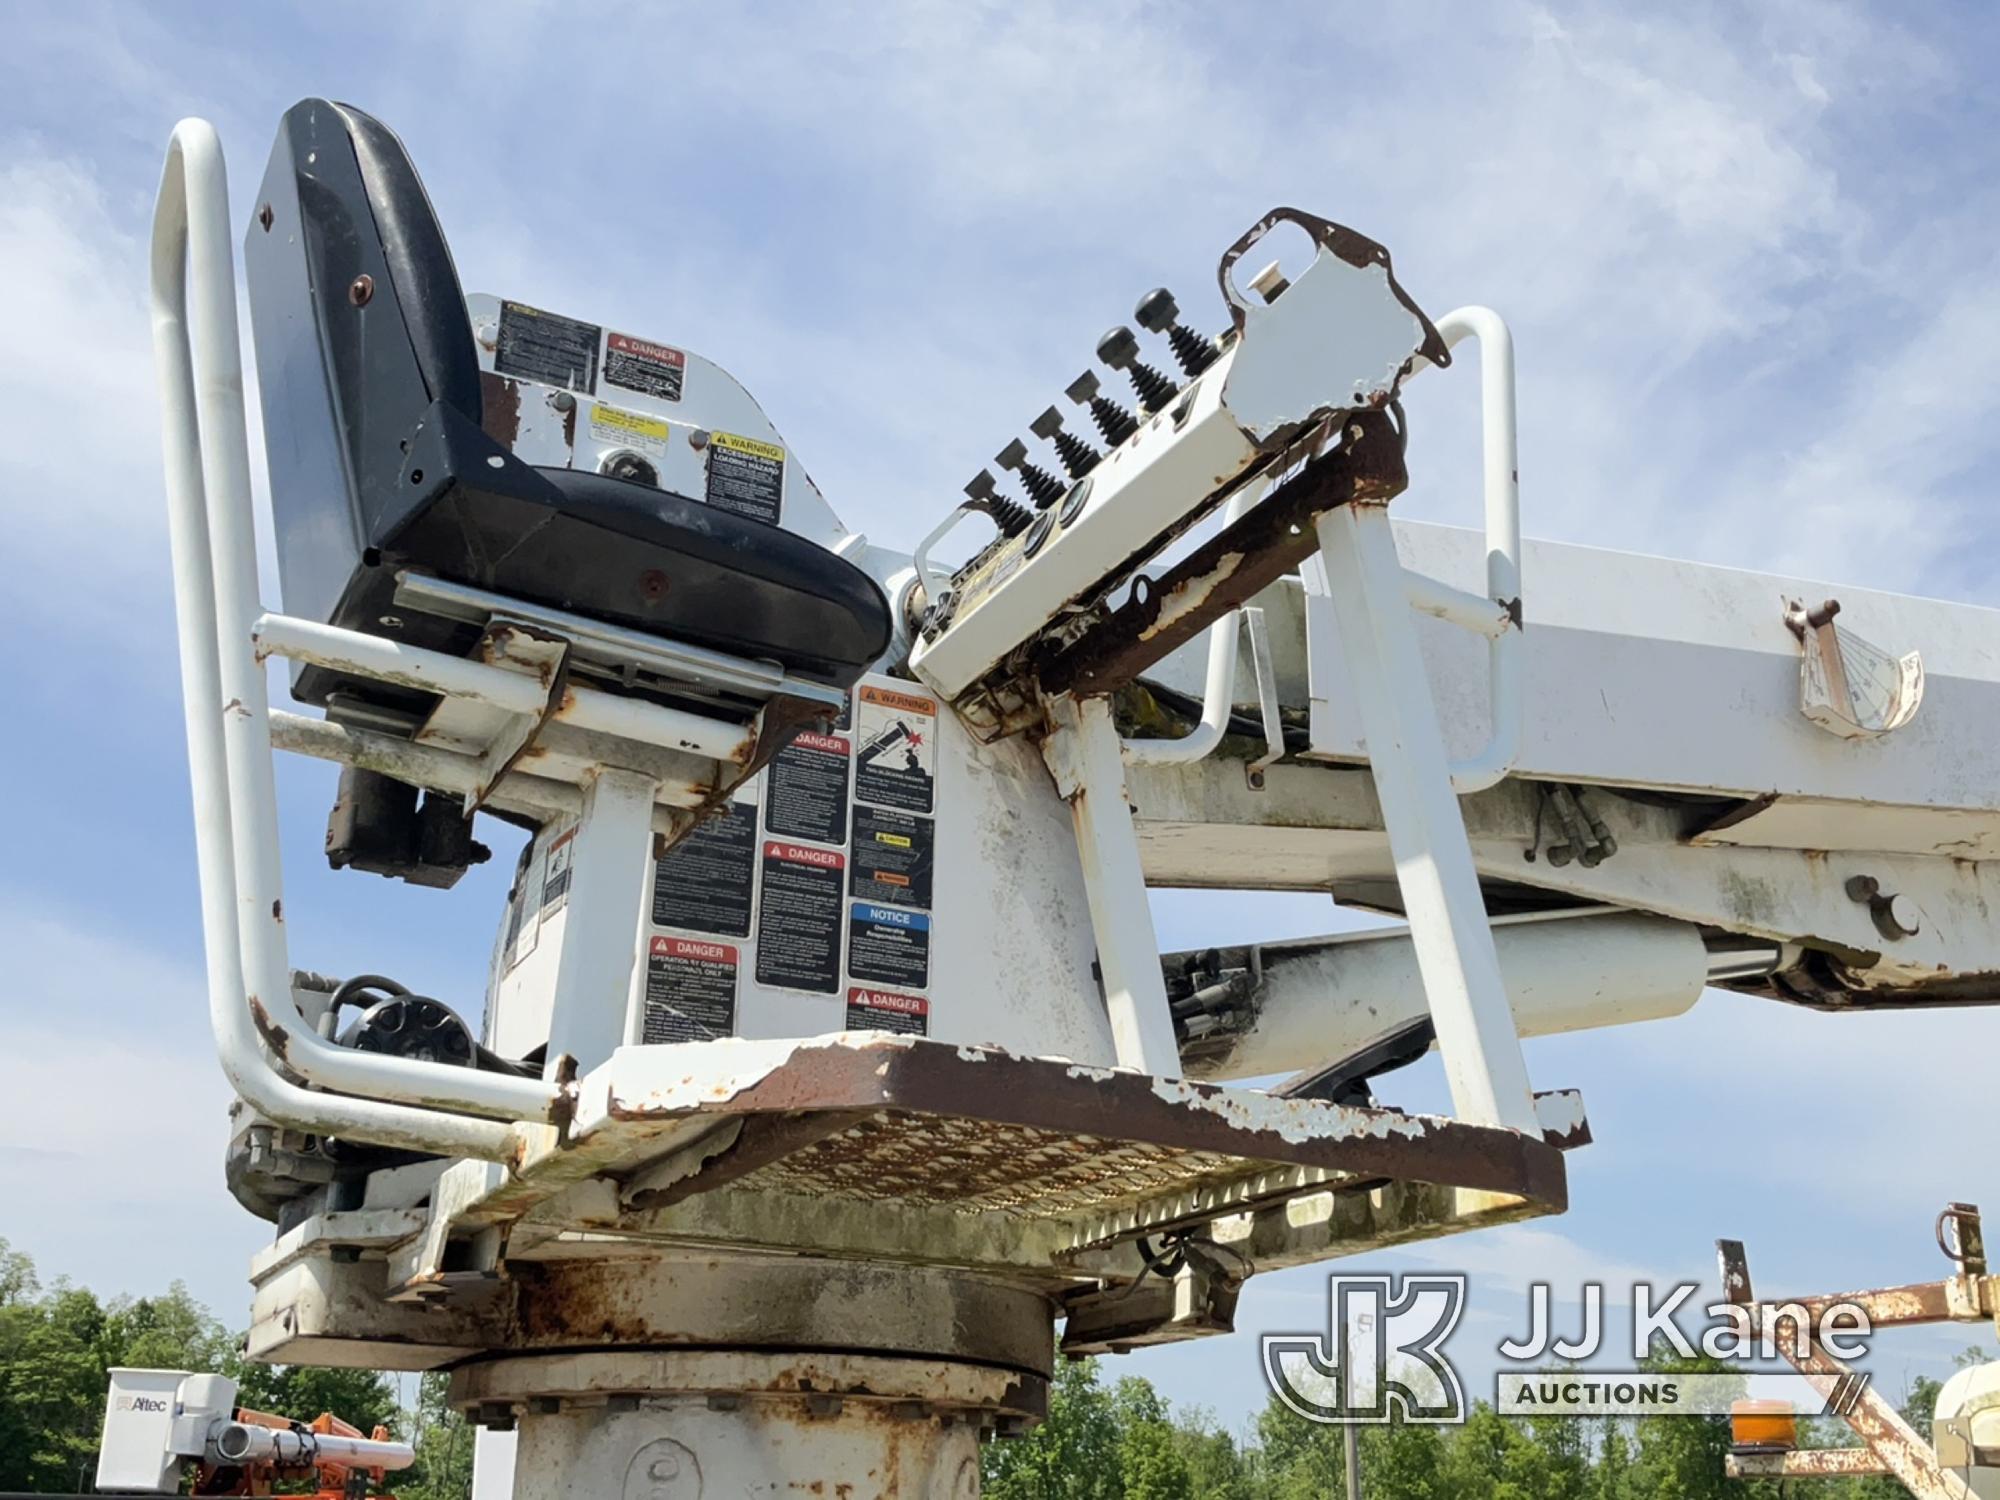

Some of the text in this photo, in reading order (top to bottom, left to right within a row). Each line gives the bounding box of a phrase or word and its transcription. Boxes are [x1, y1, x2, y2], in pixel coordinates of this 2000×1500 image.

[631, 341, 676, 362] DANGER
[730, 437, 778, 457] WARNING
[881, 692, 930, 712] WARNING
[796, 733, 842, 751] DANGER
[788, 848, 837, 865] DANGER
[870, 909, 911, 924] NOTICE
[677, 942, 724, 958] DANGER
[701, 961, 736, 972] QUALIFIED
[872, 994, 920, 1011] DANGER
